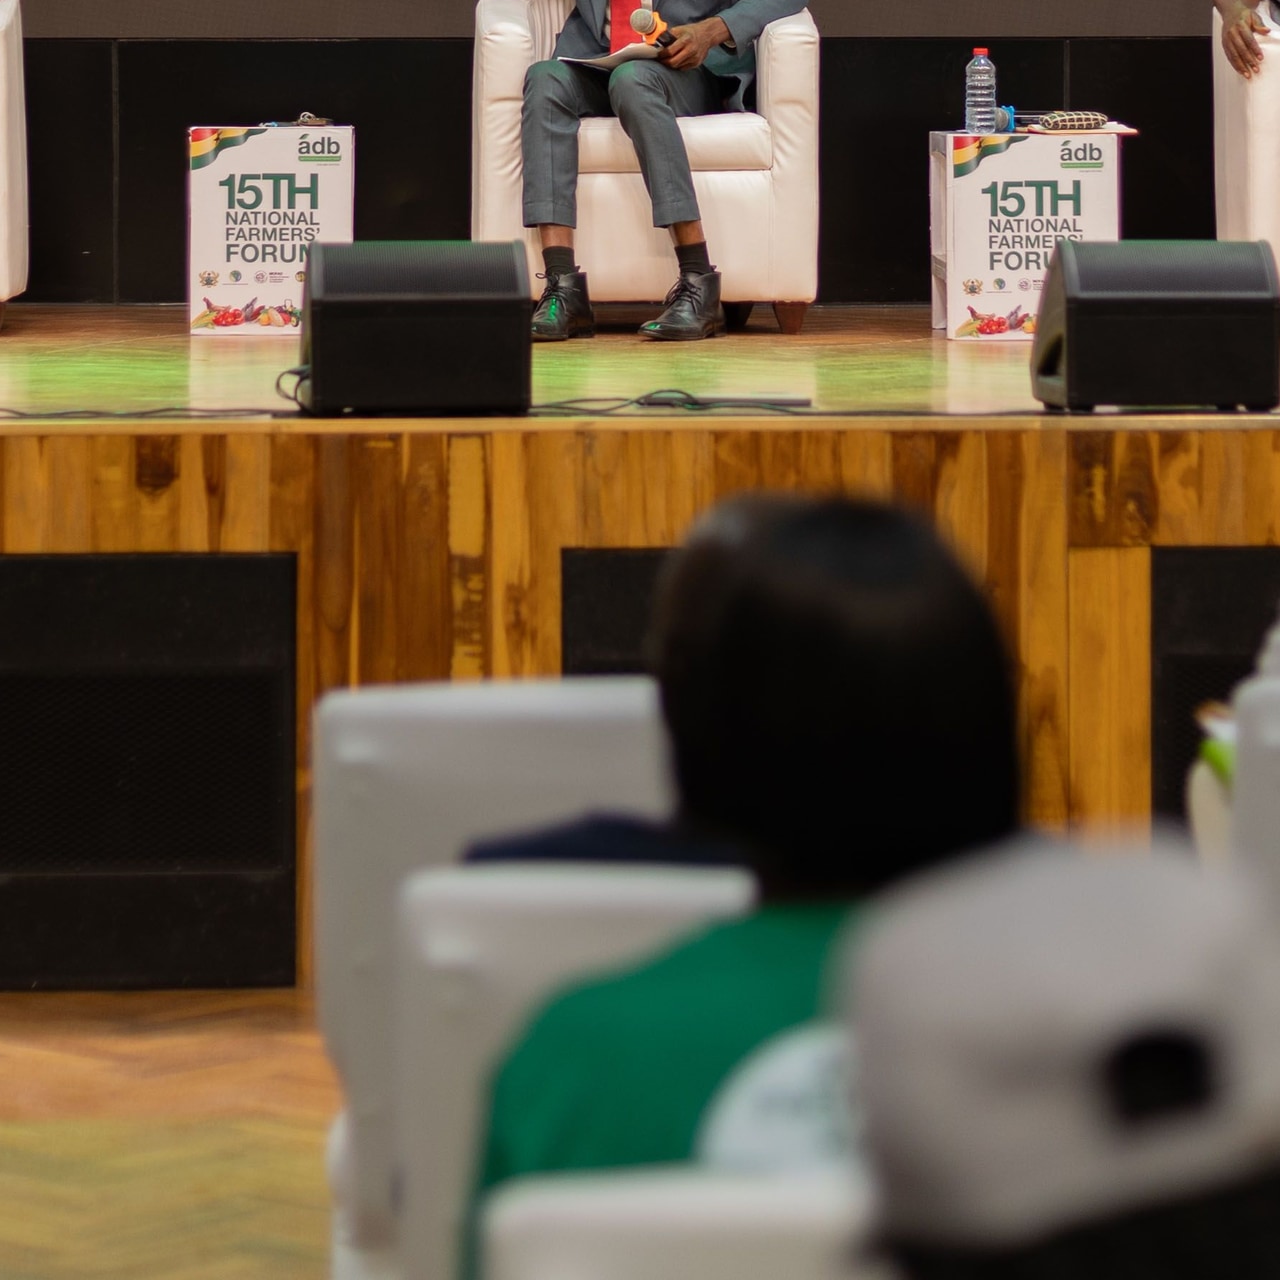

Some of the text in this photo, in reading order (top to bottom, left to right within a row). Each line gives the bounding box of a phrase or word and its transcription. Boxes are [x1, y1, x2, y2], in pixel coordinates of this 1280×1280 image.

[219, 173, 319, 210] 15TH
[981, 180, 1081, 217] 15TH
[226, 211, 320, 226] NATIONAL
[989, 218, 1083, 233] NATIONAL
[226, 227, 320, 242] FARMERS'
